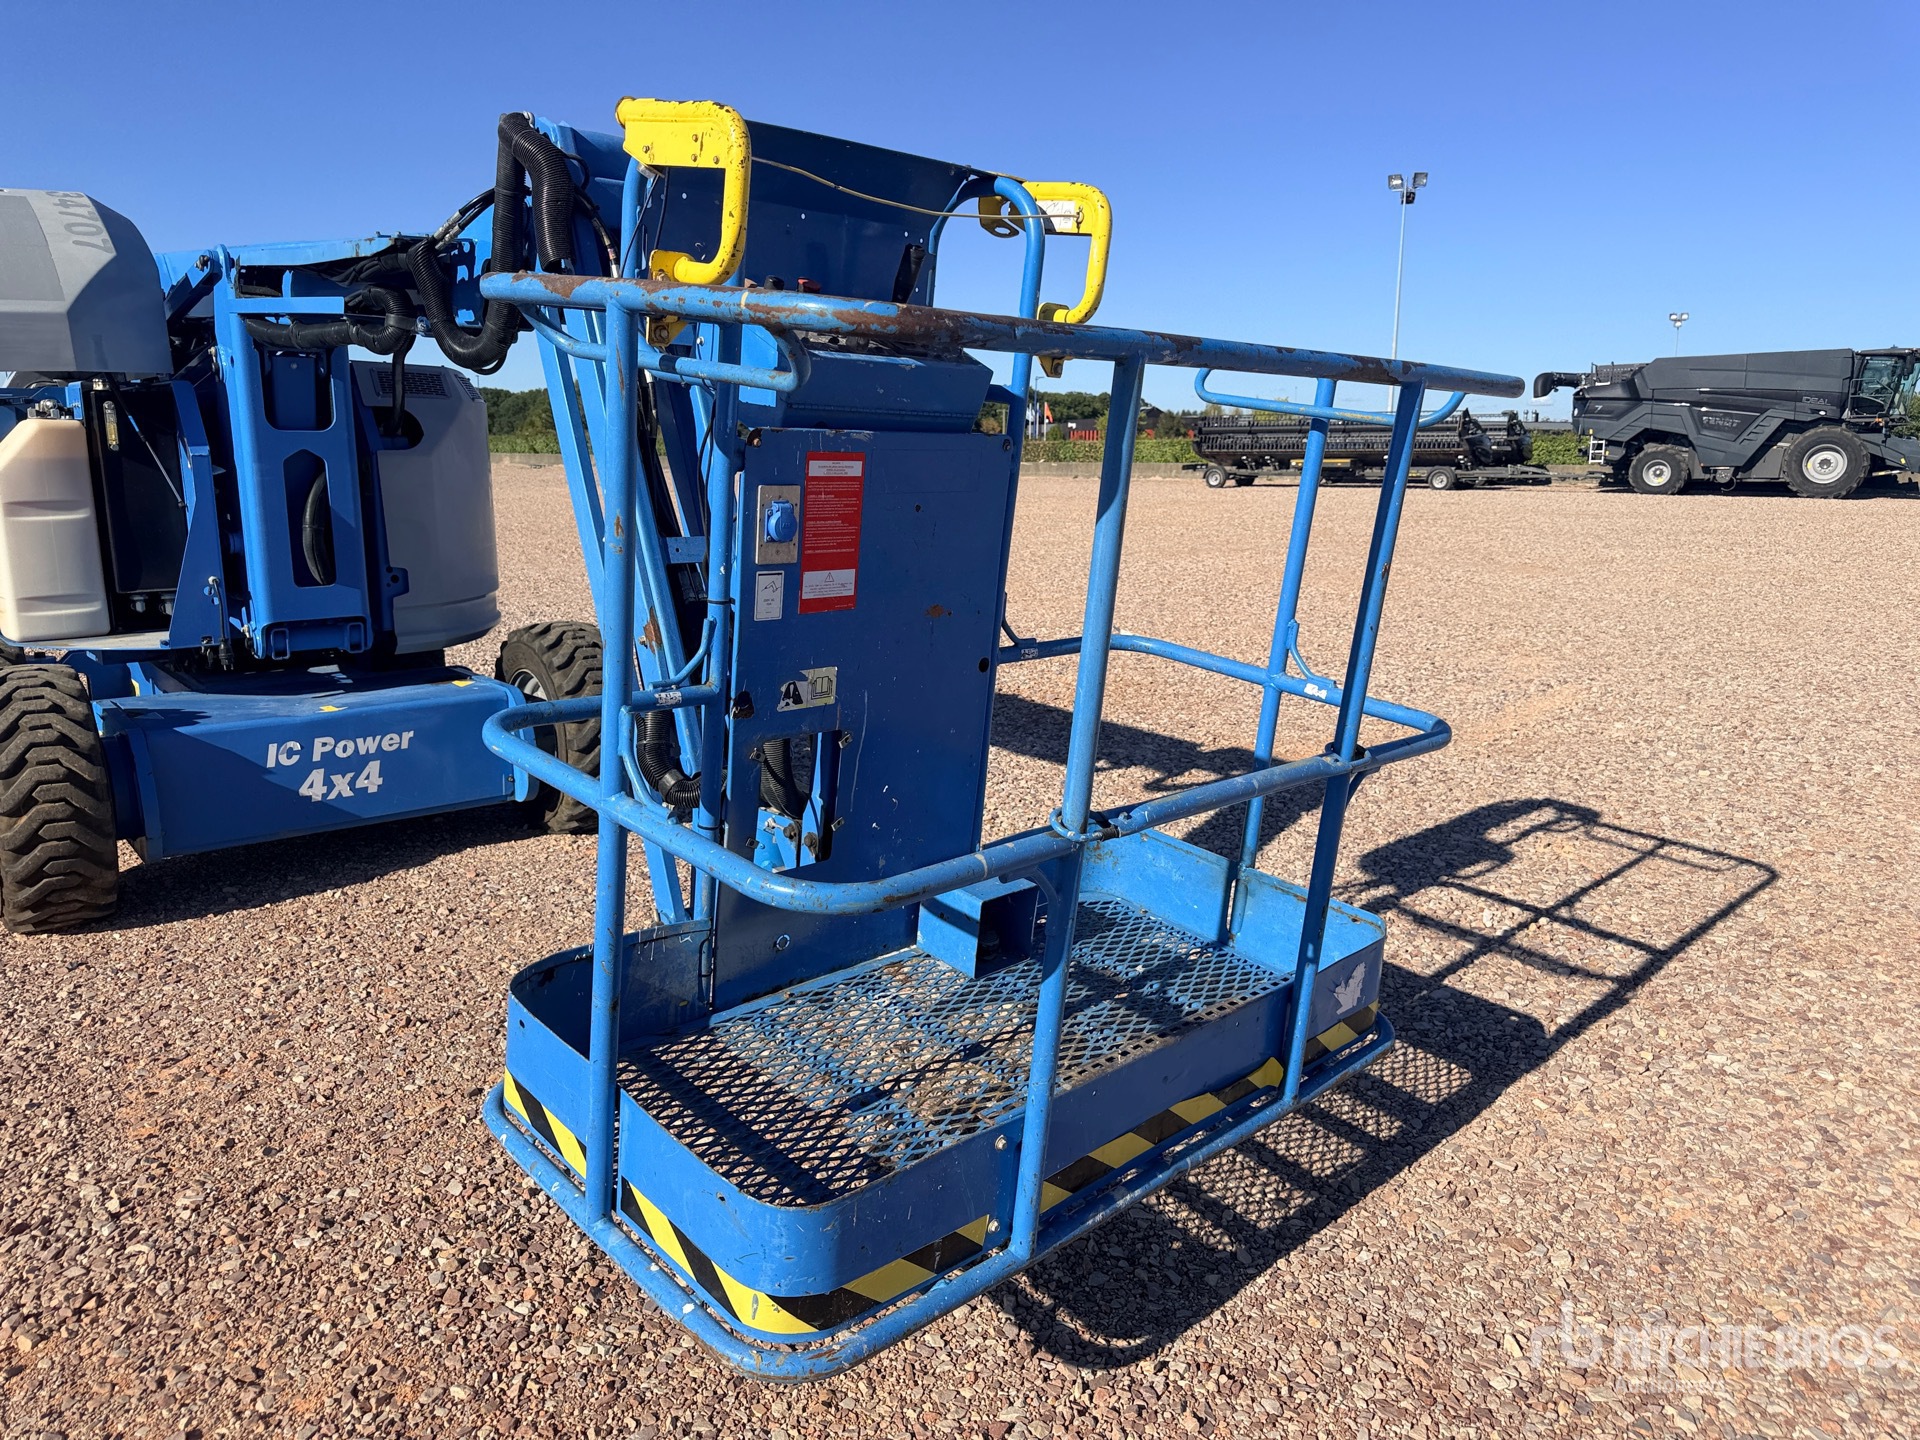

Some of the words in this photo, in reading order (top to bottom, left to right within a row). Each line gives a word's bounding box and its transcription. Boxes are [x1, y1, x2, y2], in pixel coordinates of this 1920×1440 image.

[266, 740, 302, 769] IC
[312, 730, 415, 762] Power
[298, 759, 384, 802] 4x4
